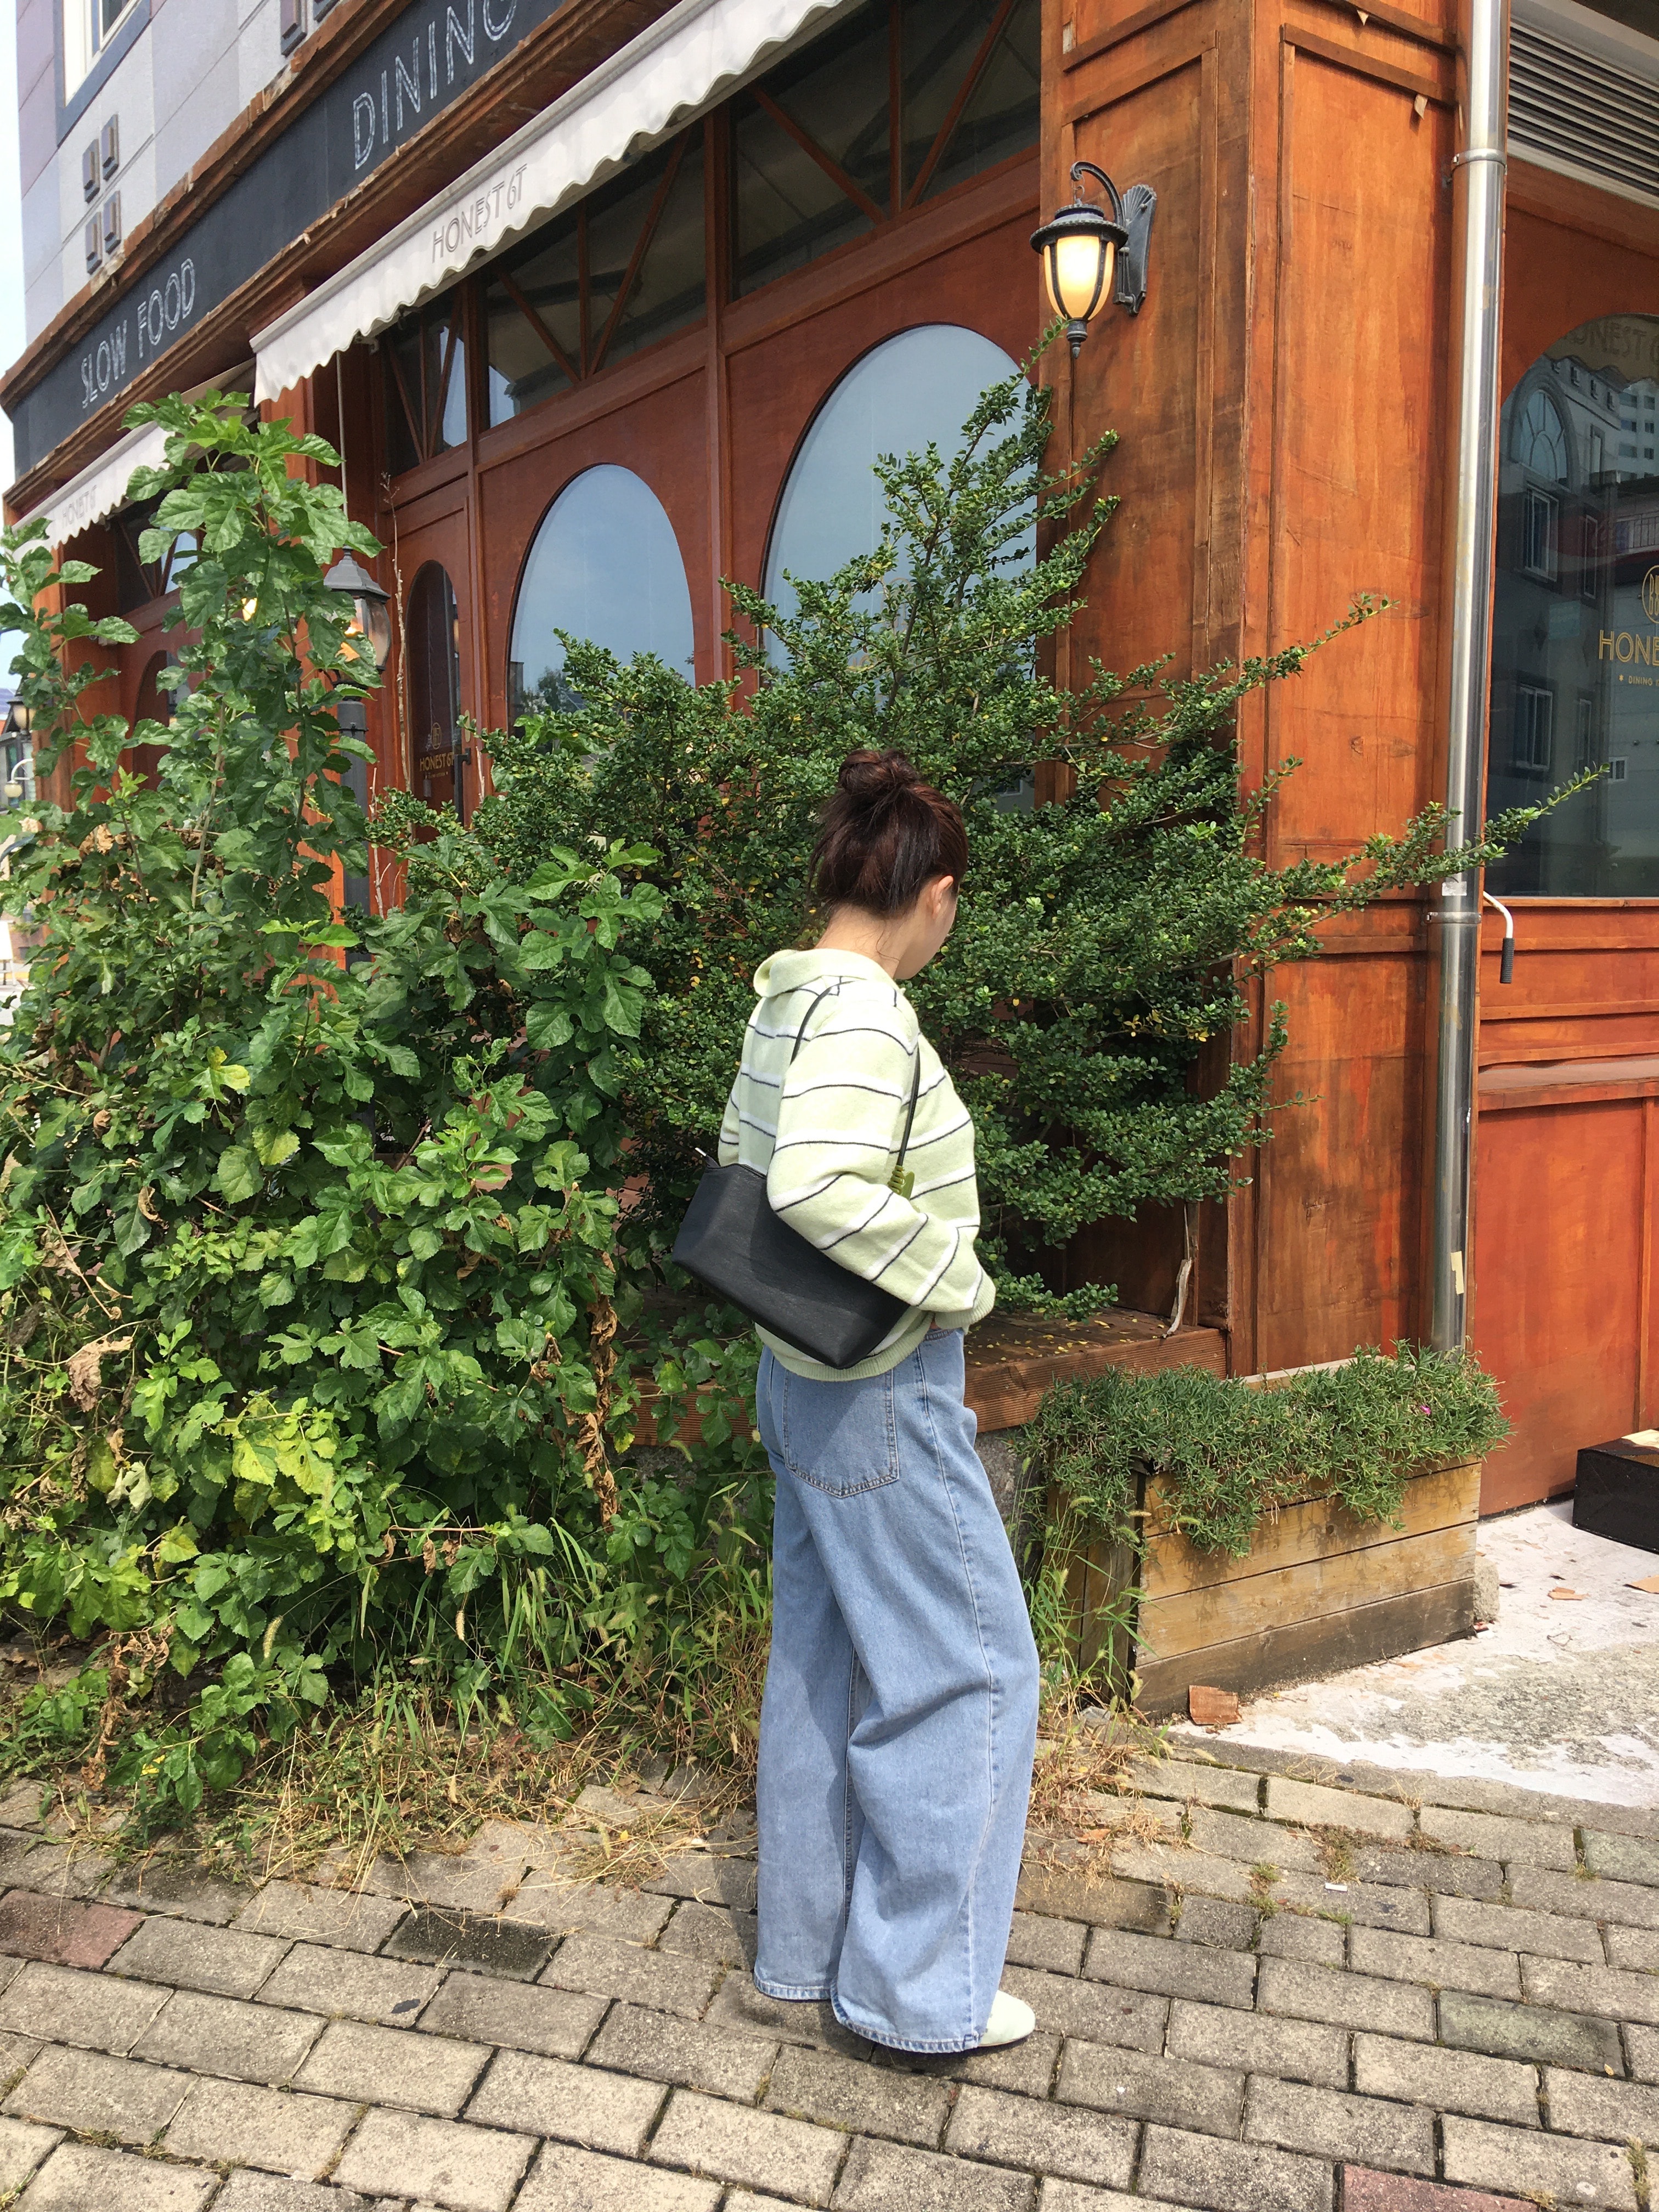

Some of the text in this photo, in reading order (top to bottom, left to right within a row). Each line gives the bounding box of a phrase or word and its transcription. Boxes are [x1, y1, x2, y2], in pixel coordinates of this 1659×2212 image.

[432, 180, 505, 263] HONEST
[82, 258, 195, 409] SLOW FOOD
[1628, 675, 1653, 686] DINING
[420, 753, 447, 772] HONEST
